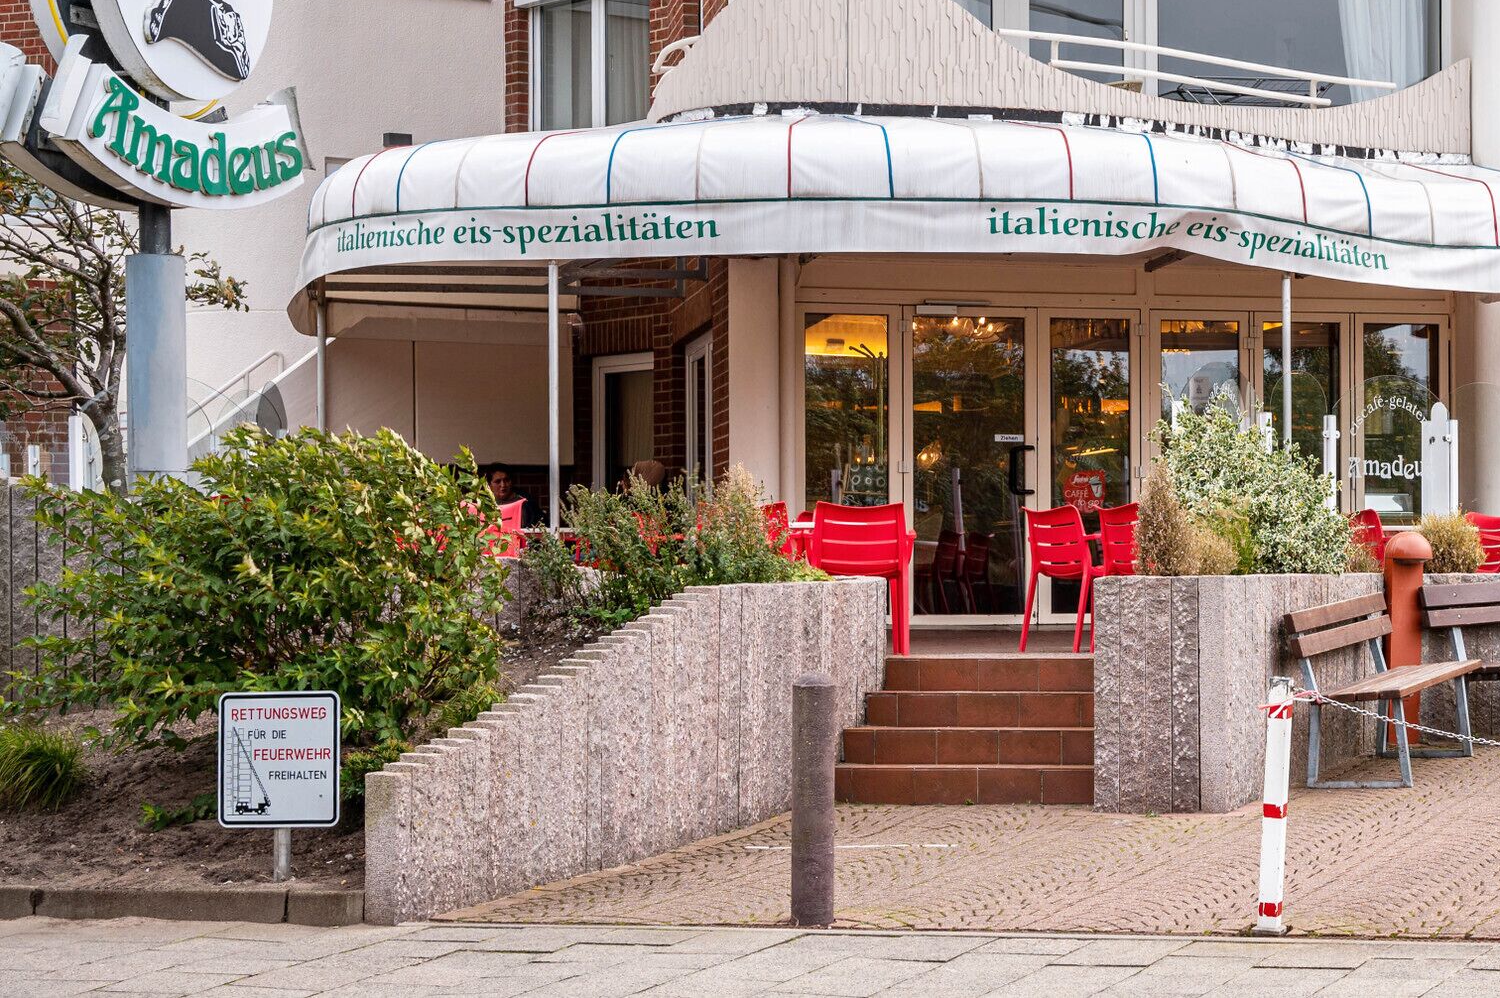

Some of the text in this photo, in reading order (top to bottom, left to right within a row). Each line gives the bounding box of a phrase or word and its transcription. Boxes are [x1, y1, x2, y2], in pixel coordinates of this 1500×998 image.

[90, 76, 304, 196] Amadeus
[336, 212, 722, 254] italienische eis-spezialitäten
[986, 206, 1390, 270] italienische eis-spezialitäten
[1349, 394, 1428, 436] eiscafé-gelater
[1348, 454, 1424, 480] Amadeu
[231, 707, 327, 720] RETTUNGSWEG
[247, 729, 287, 739] FÜR DIE
[253, 748, 331, 761] FEUERWEHR
[268, 770, 327, 780] FREIHALTEN
